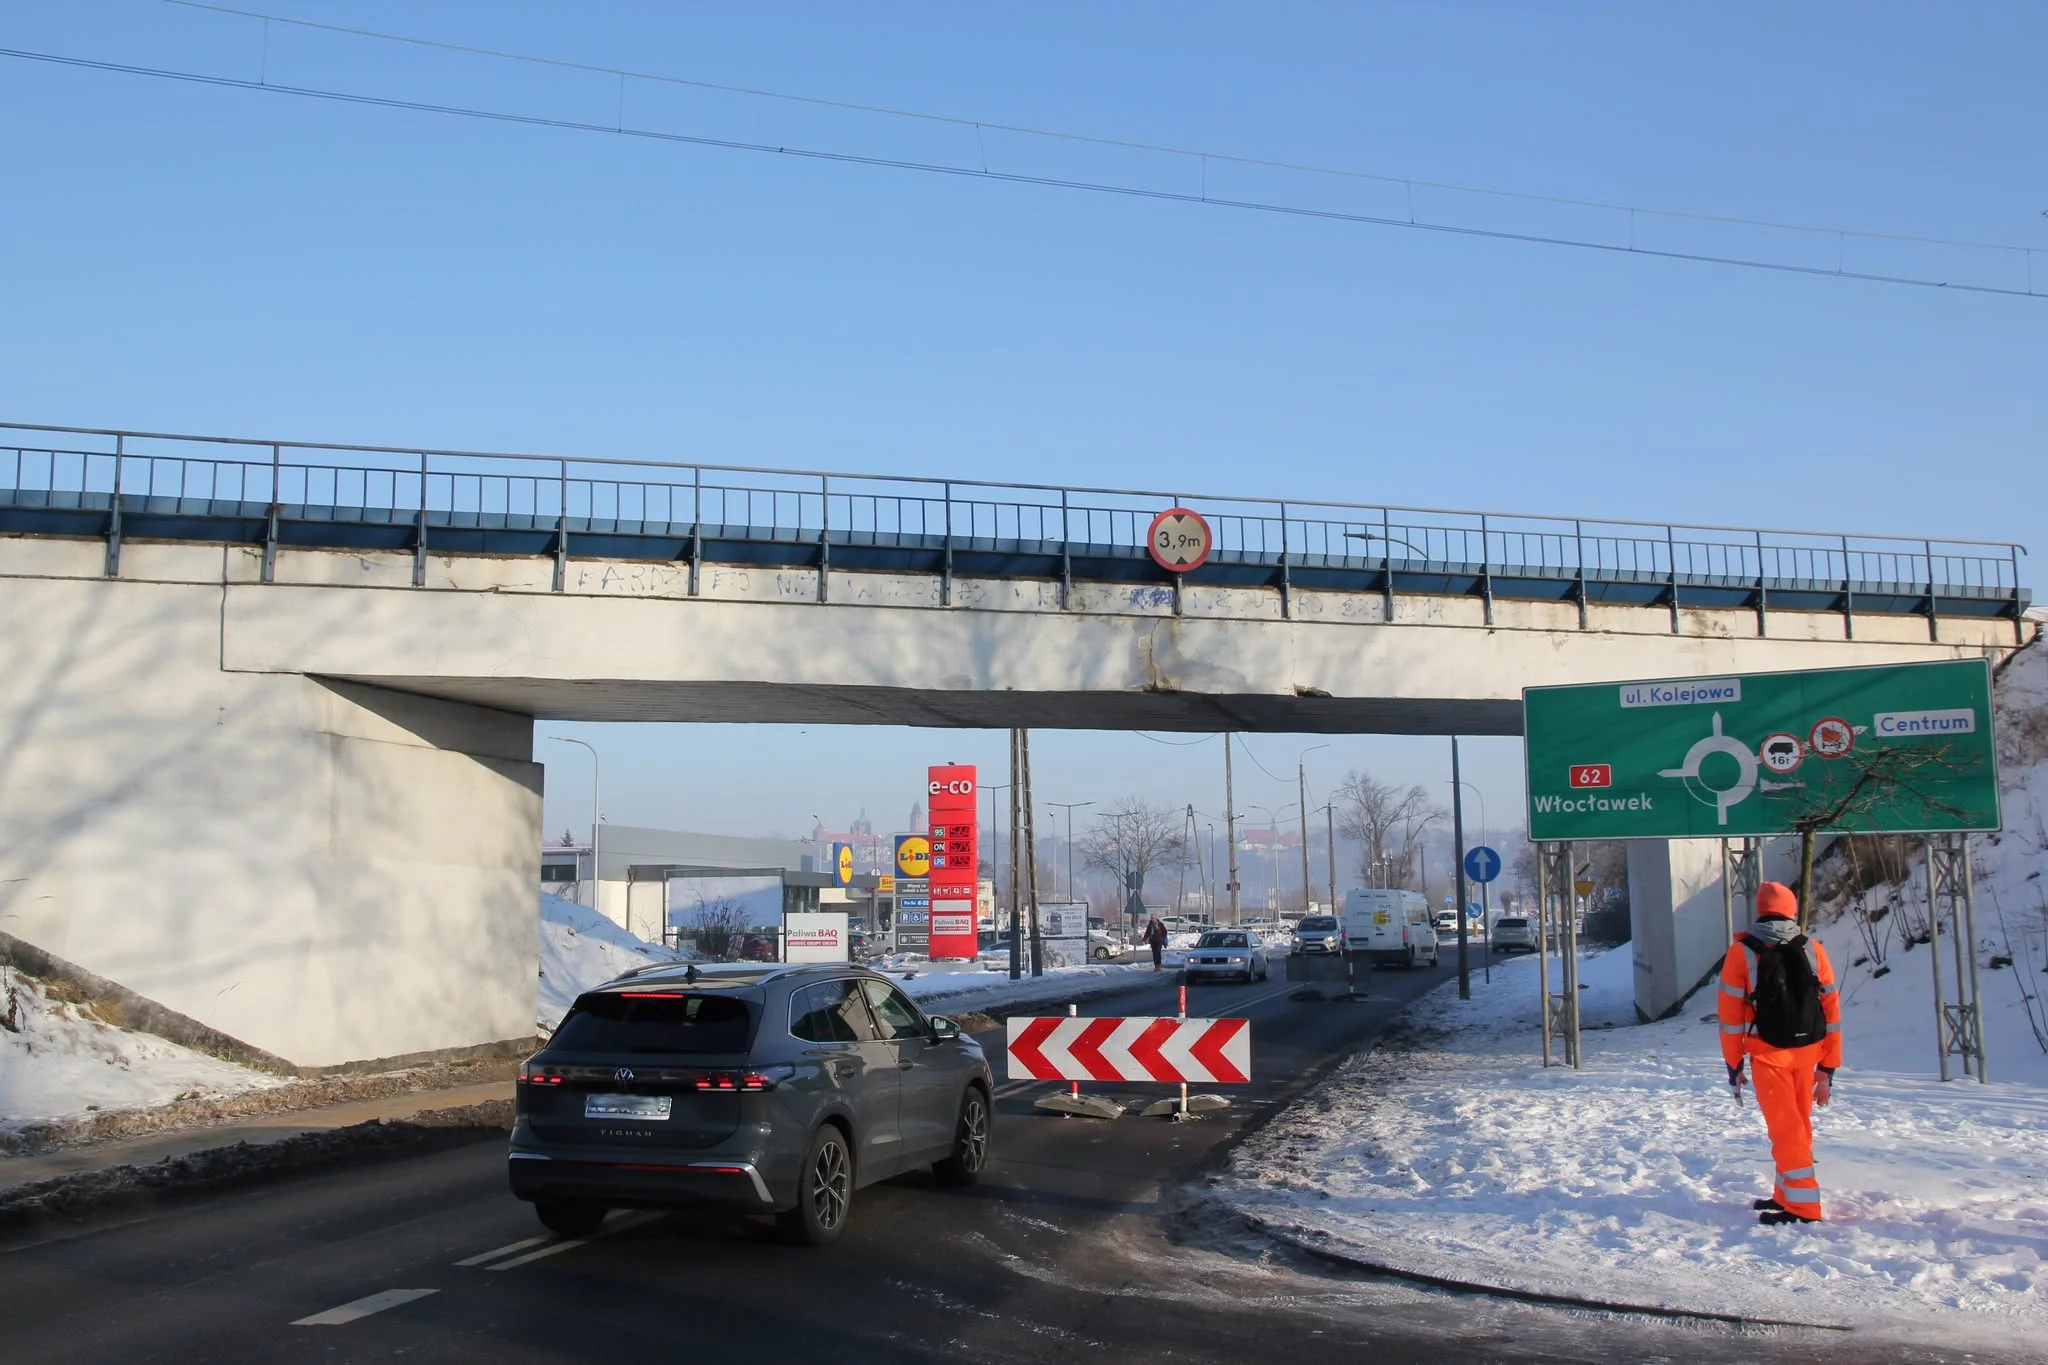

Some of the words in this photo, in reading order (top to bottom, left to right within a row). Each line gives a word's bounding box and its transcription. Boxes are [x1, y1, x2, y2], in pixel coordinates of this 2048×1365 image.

[1159, 531, 1200, 550] 3,9m
[1626, 689, 1646, 704] ul.
[1650, 685, 1734, 703] Kolejowa
[1880, 715, 1969, 732] Centrum
[1771, 756, 1790, 765] 16t
[1580, 769, 1601, 784] 62
[929, 780, 972, 795] e-co
[1534, 792, 1653, 813] Włocławek
[934, 828, 944, 837] 95
[934, 842, 945, 851] ON
[934, 857, 944, 865] LPG
[787, 929, 817, 937] Paliwa
[818, 929, 838, 939] BAQ
